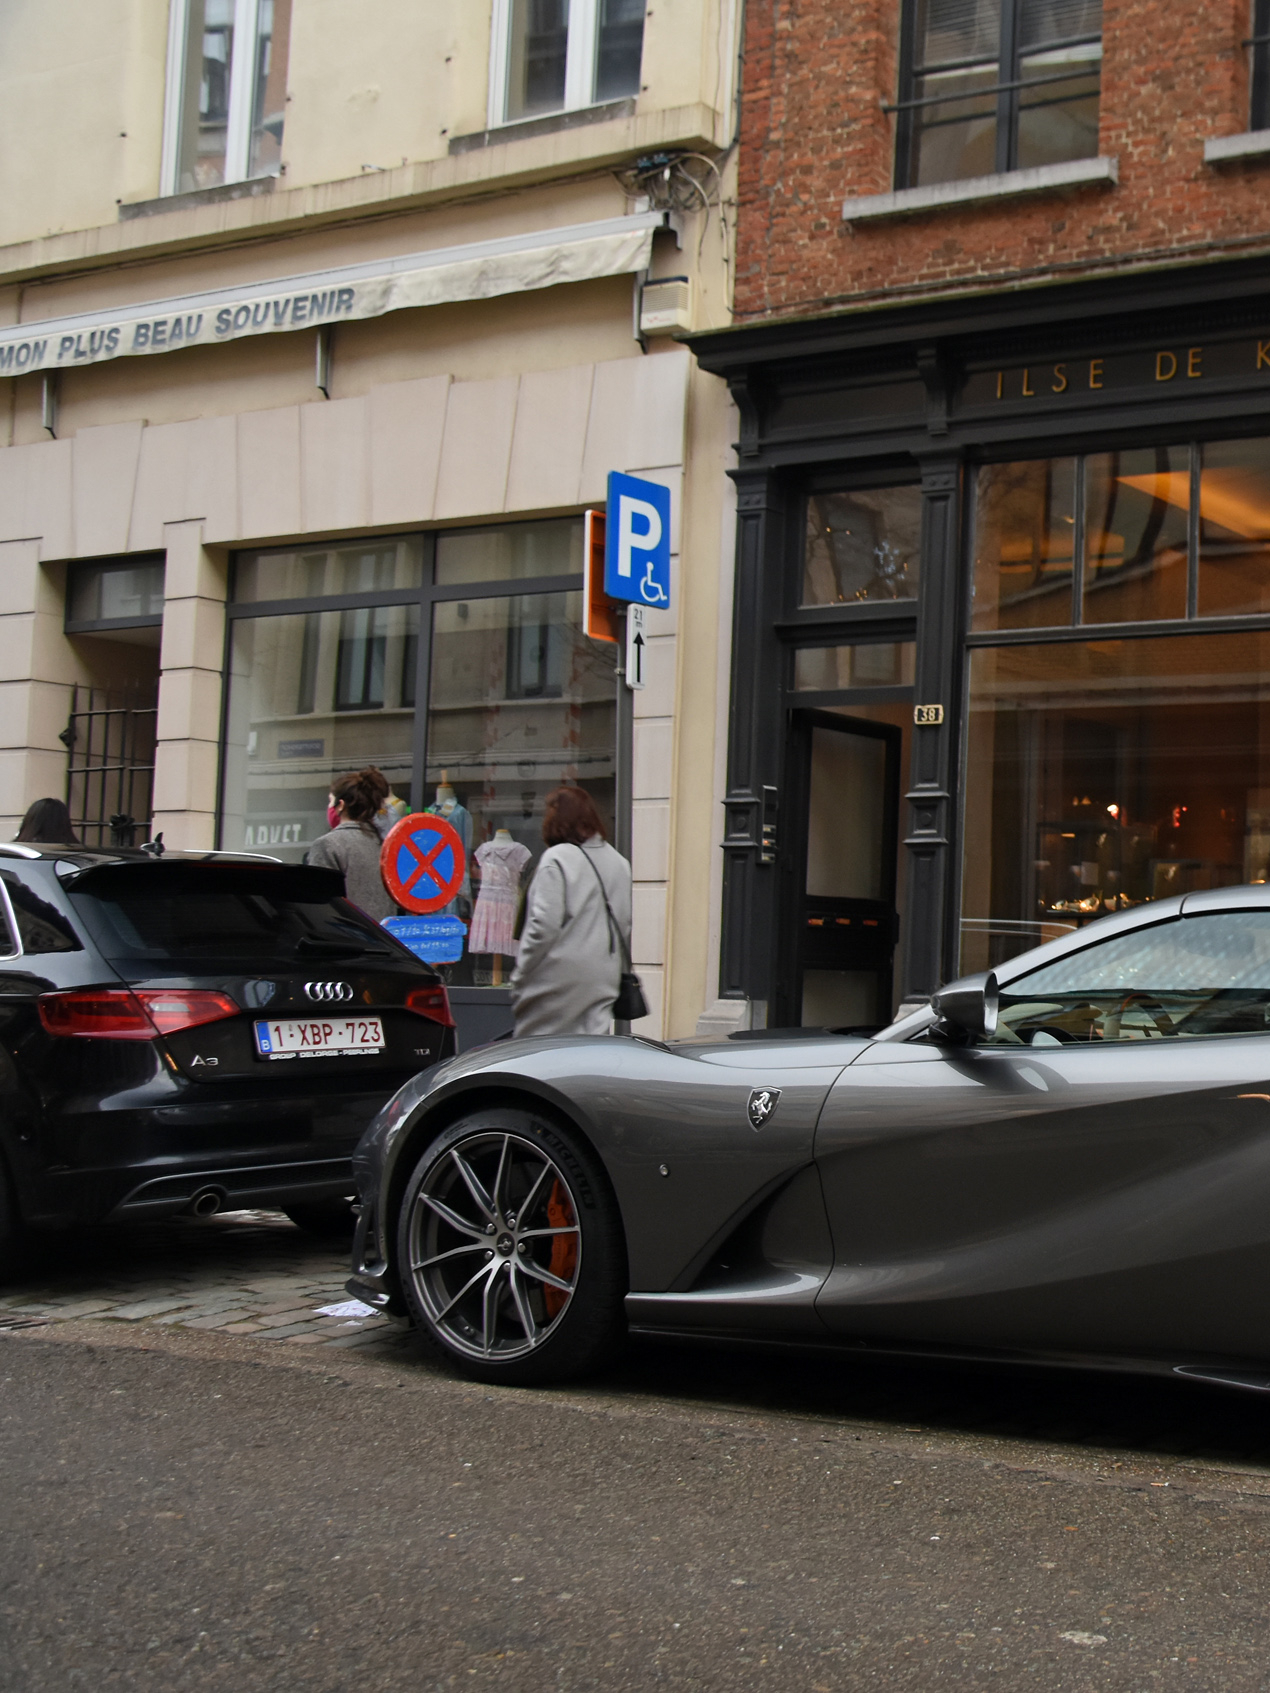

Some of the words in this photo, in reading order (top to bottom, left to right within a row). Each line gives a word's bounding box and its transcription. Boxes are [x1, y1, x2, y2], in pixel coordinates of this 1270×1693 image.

[0, 340, 47, 369] MON
[58, 328, 120, 360] PLUS
[133, 314, 203, 349] BEAU
[216, 288, 355, 334] SOUVENIR
[996, 359, 1104, 398] ILSE
[1155, 347, 1203, 381] DE
[617, 494, 663, 578] P
[921, 708, 936, 721] 38
[191, 1055, 218, 1067] A3
[262, 1040, 271, 1050] B
